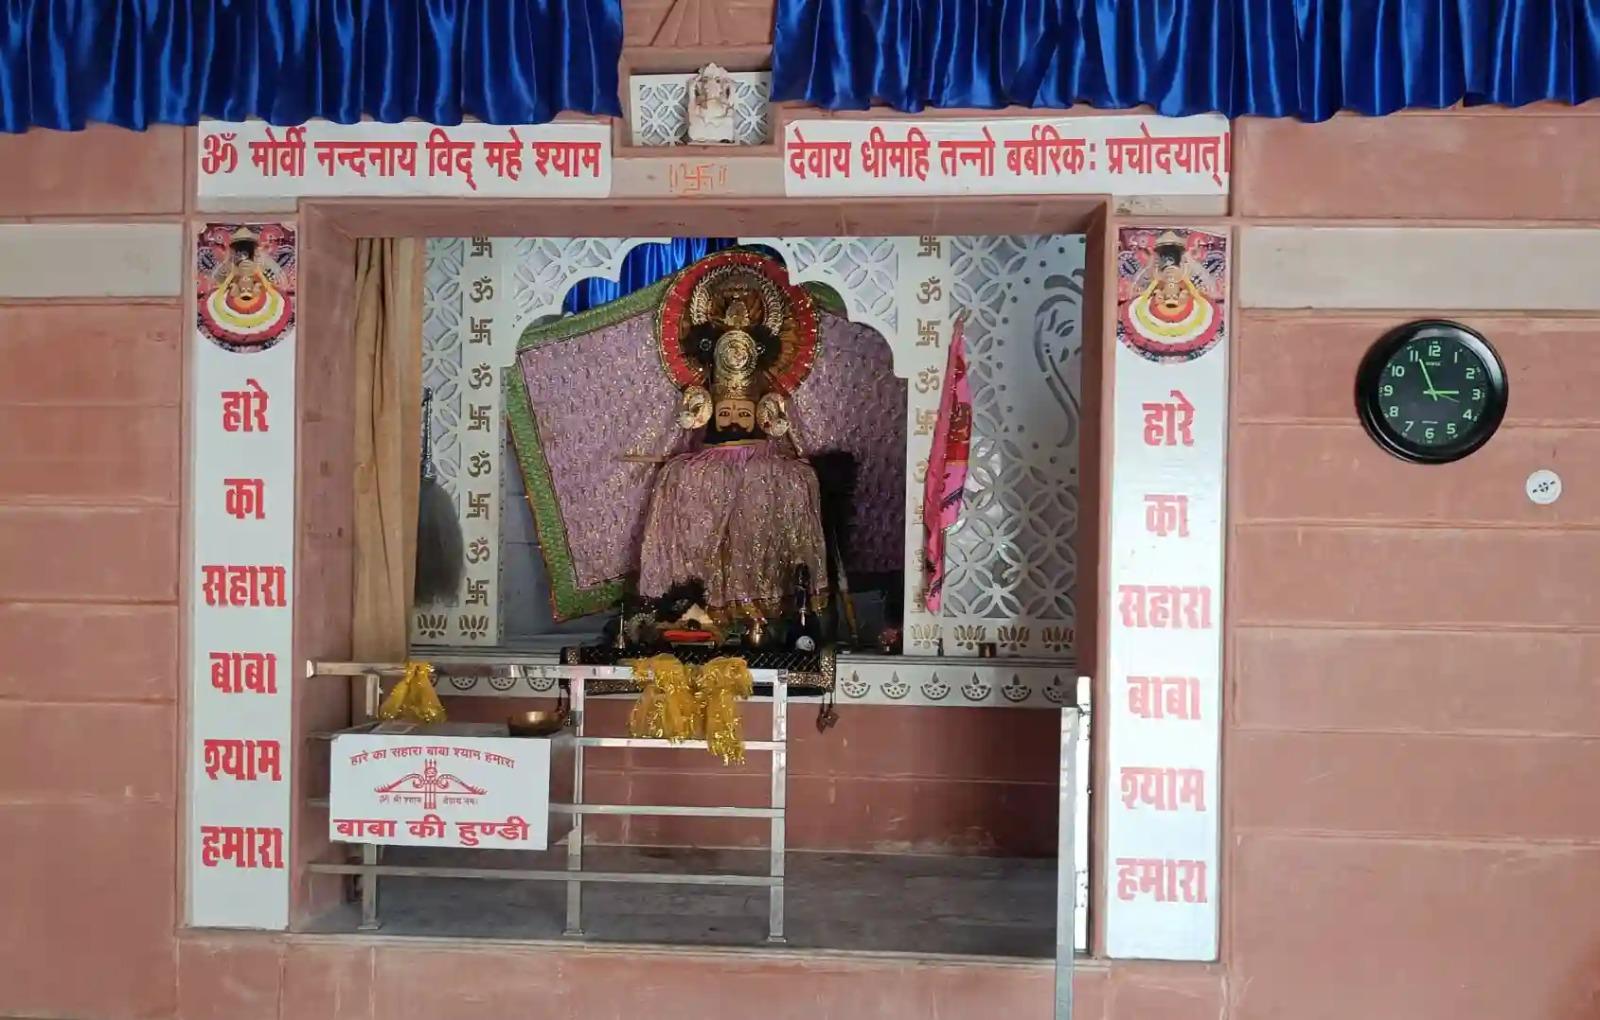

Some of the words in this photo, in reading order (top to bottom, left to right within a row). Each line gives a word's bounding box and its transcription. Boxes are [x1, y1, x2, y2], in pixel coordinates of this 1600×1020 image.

[201, 133, 238, 175] ॐ
[249, 126, 306, 177] मोर्वी
[313, 141, 417, 176] नन्दनाय
[424, 128, 477, 189] विद्
[484, 129, 523, 181] महे
[532, 141, 602, 177] श्याम
[787, 127, 851, 179] देवाय
[861, 127, 931, 181] धीमहि
[938, 126, 996, 176] तन्नो
[1391, 365, 1405, 377] 10
[1410, 350, 1419, 362] 11
[1428, 345, 1441, 357] 12
[1454, 351, 1458, 364] 1
[1383, 385, 1393, 396] 9
[1465, 367, 1475, 380] 2
[1471, 388, 1481, 401] 3
[221, 379, 270, 432] हारे
[1142, 390, 1195, 447] हारे
[1389, 405, 1399, 417] 8
[1405, 420, 1414, 432] 7
[1462, 408, 1472, 420] 4
[1425, 427, 1435, 439] 6
[1446, 423, 1456, 434] 5
[224, 478, 266, 520] का
[1145, 494, 1189, 537] का
[203, 565, 286, 607] सहारा
[1118, 584, 1211, 629] सहारा
[211, 652, 277, 695] बाबा
[1126, 675, 1201, 720] बाबा
[204, 739, 282, 781] श्याम
[1120, 767, 1206, 812] श्याम
[202, 826, 284, 868] हमारा
[333, 819, 397, 837] बाबा
[406, 814, 446, 838] की
[456, 815, 531, 847] हुण्डी
[1116, 858, 1207, 903] हमारा
